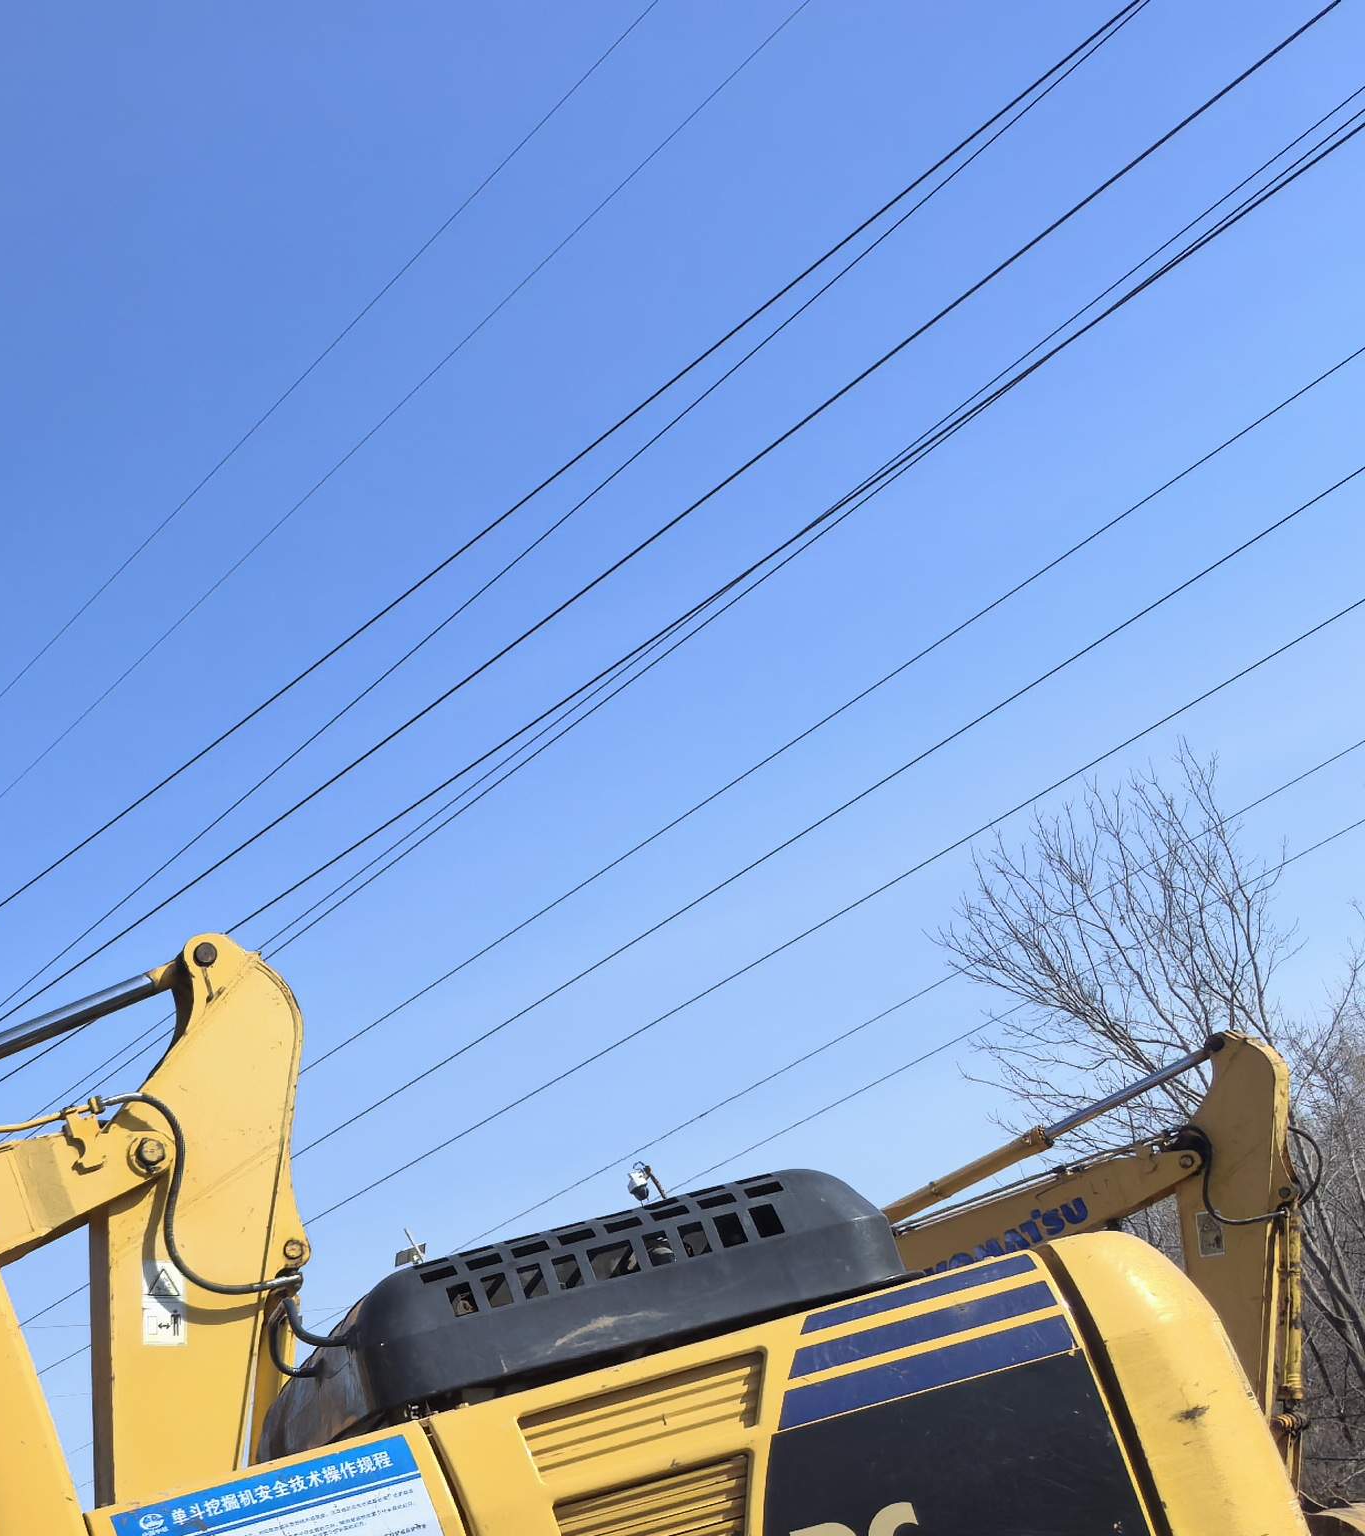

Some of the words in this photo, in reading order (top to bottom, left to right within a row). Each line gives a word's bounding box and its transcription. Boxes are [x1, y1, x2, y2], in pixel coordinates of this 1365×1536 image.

[171, 1451, 394, 1526] 单斗挖掘机安全技术操作规程
